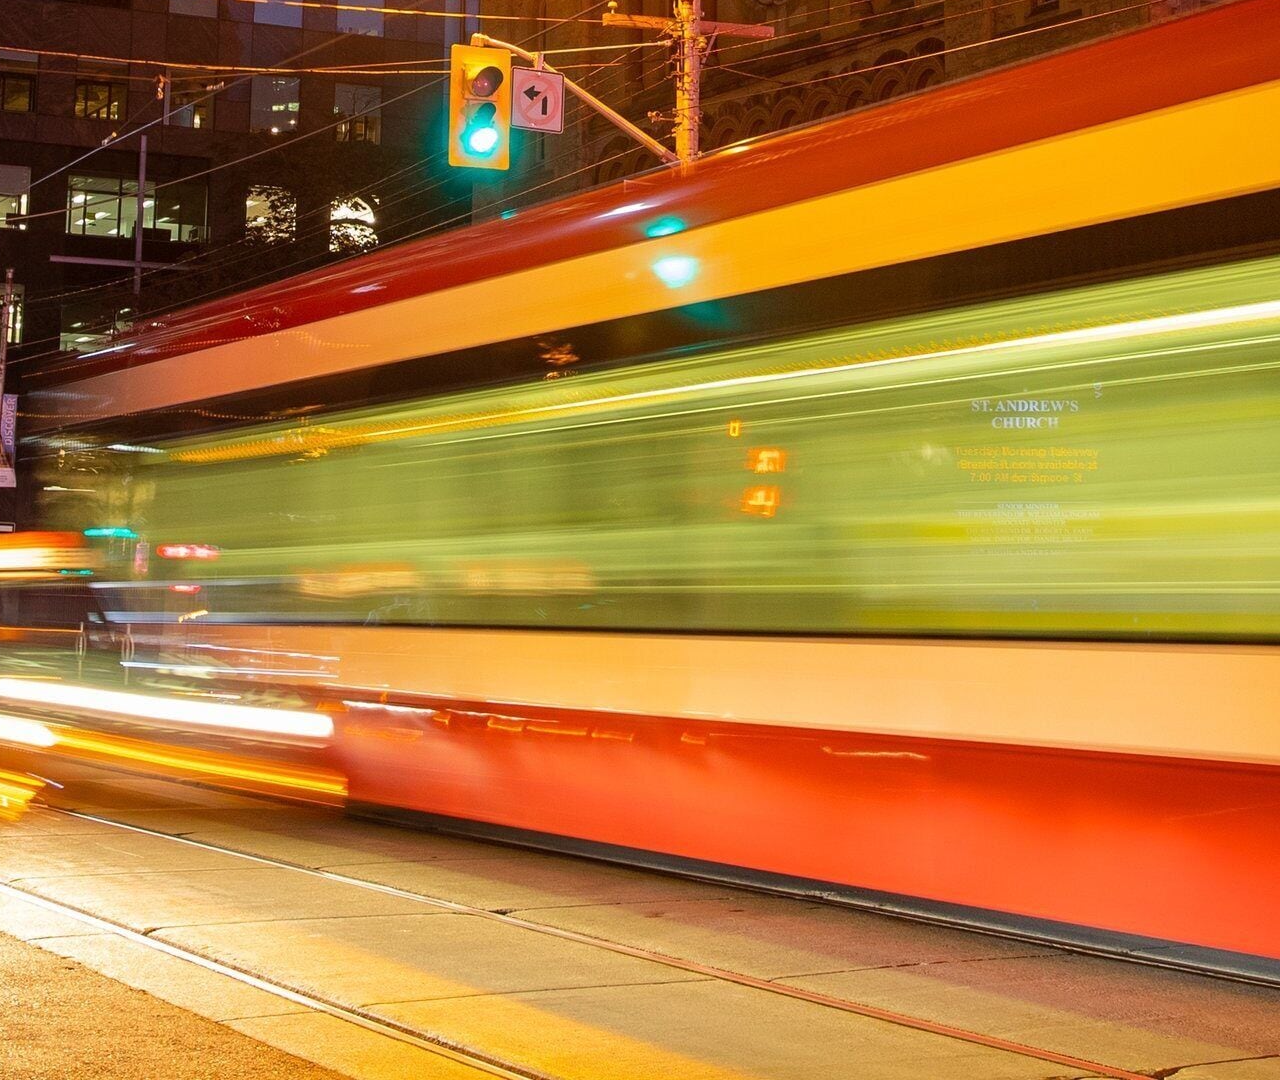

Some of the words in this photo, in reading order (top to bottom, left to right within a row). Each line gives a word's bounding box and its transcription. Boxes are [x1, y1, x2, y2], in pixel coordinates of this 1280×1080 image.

[970, 400, 993, 413] ST.
[995, 400, 1079, 413] ANDREW'S
[4, 397, 16, 446] DISCOVER
[991, 416, 1060, 430] CHURCH
